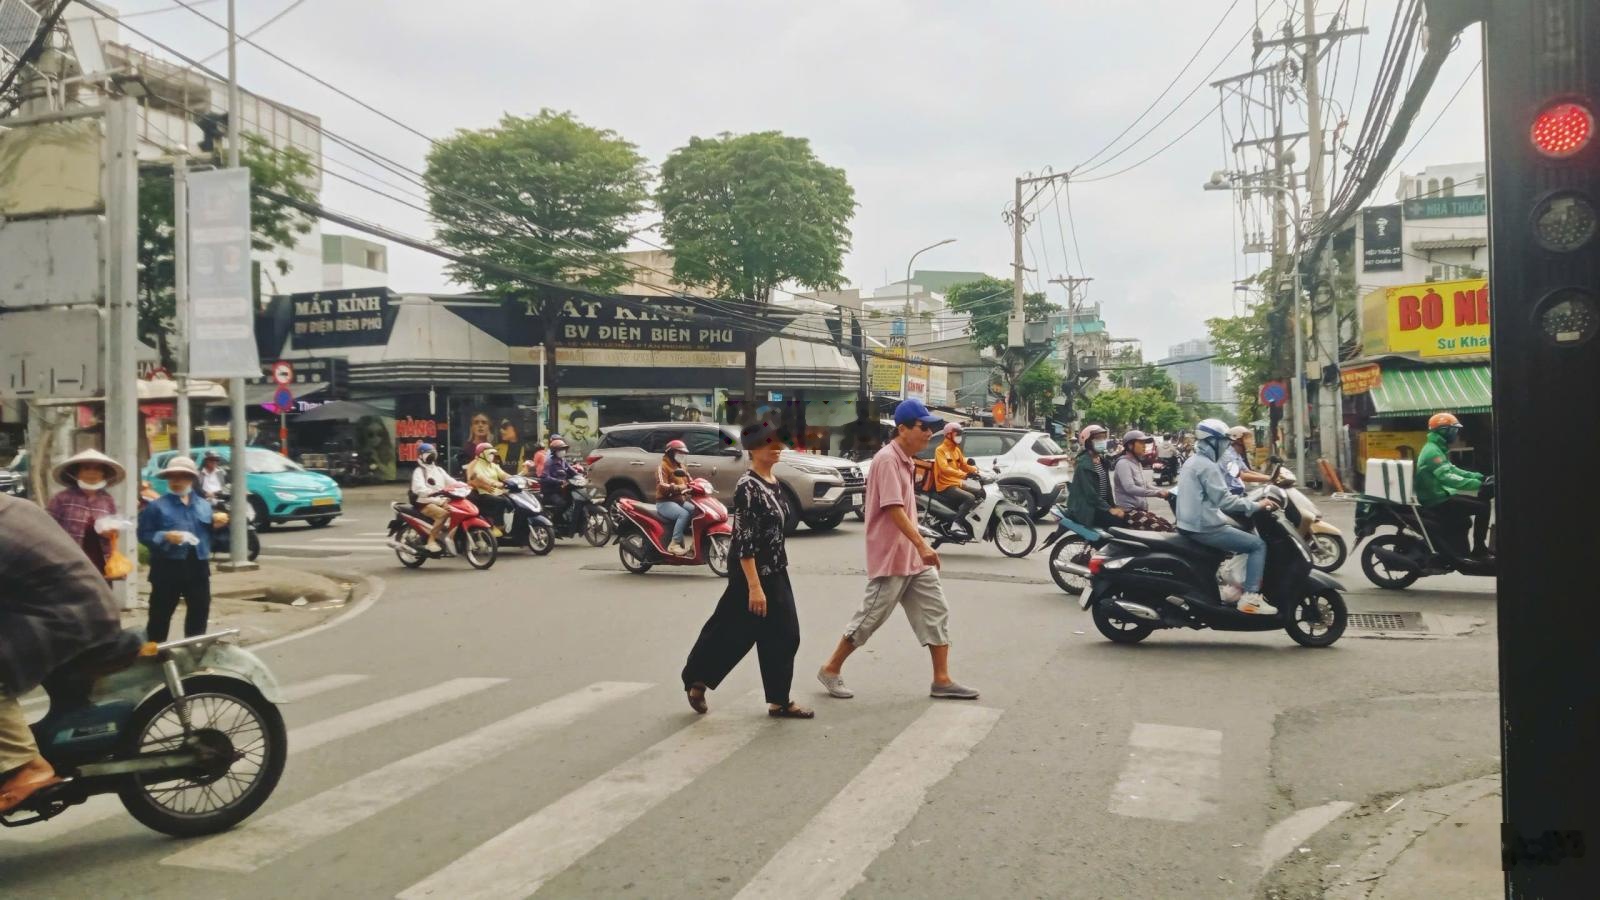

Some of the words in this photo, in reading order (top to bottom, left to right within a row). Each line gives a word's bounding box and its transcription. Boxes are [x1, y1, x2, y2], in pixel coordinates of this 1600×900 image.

[1399, 288, 1442, 331] BÒ
[565, 324, 589, 339] BV
[599, 322, 641, 343] ĐIỆN
[652, 324, 690, 341] BIÊN
